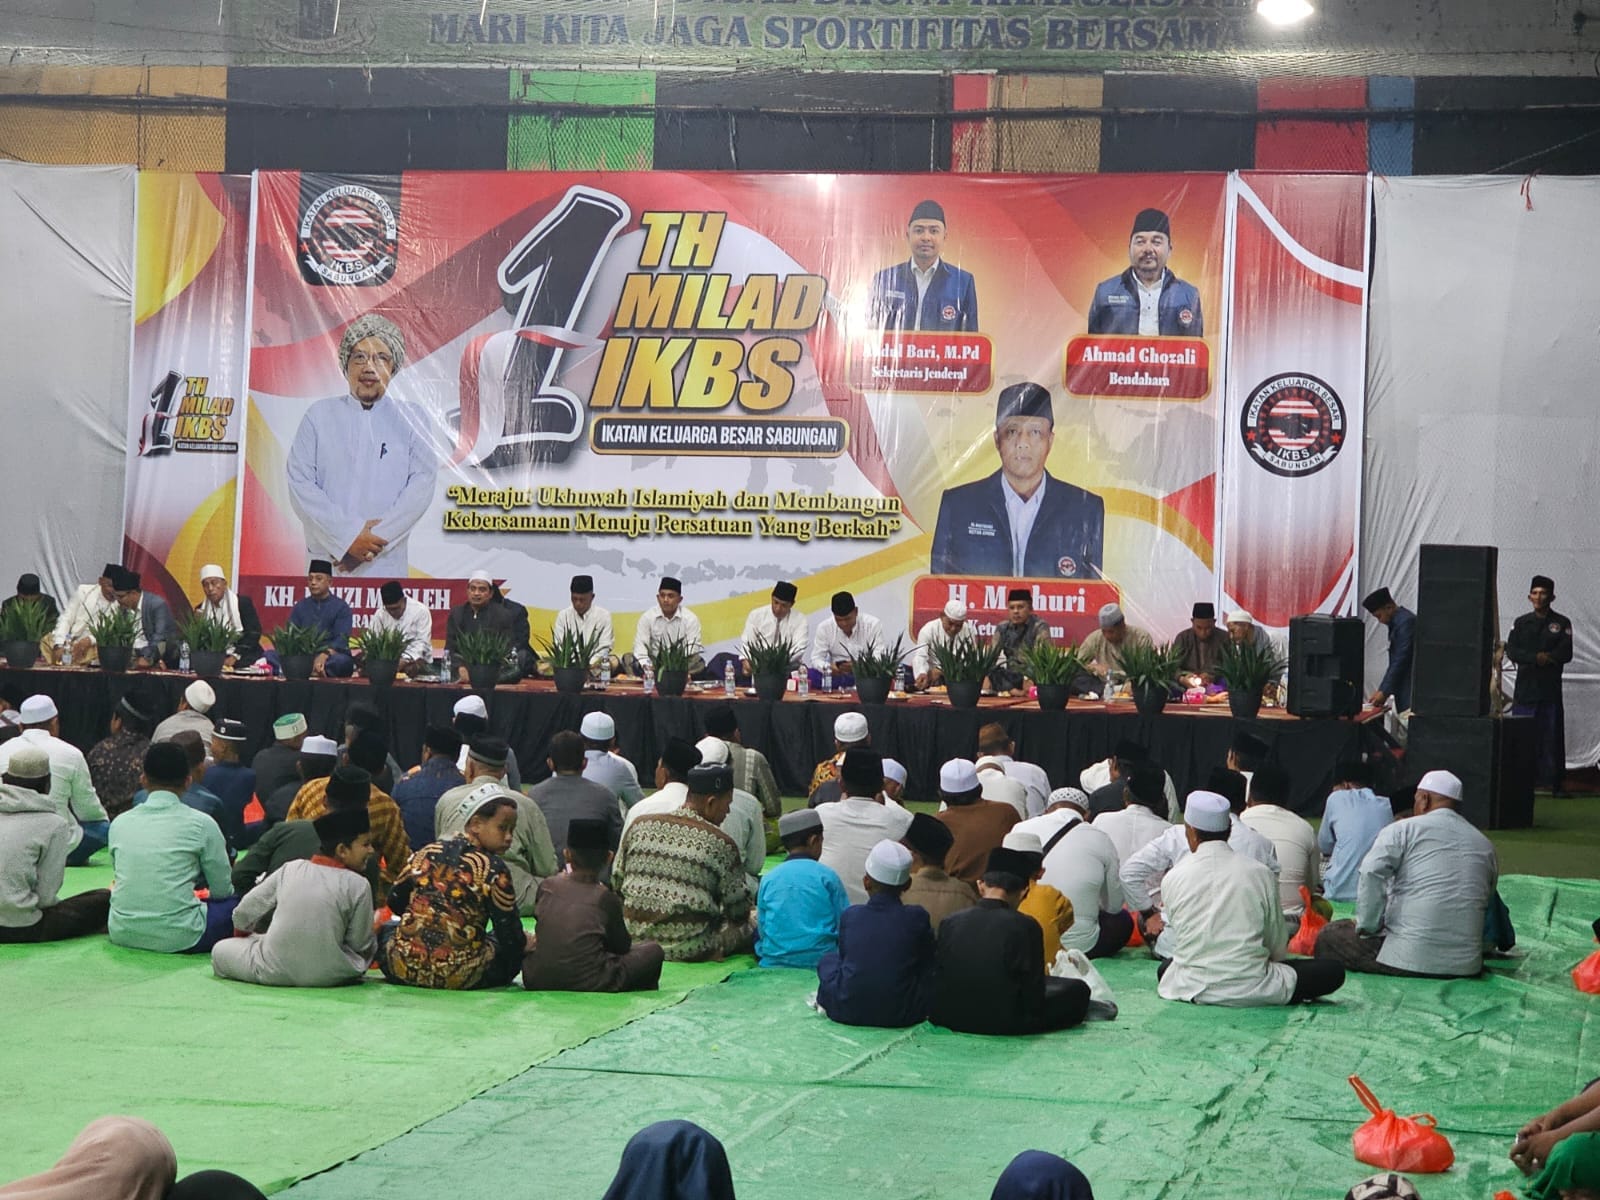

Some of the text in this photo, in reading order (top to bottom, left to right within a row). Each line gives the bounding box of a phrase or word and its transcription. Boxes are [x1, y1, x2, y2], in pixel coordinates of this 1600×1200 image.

[429, 13, 526, 45] MARI
[542, 14, 629, 46] KITA
[643, 14, 751, 48] JAGA
[764, 16, 1031, 51] SPORTIFITAS
[303, 199, 325, 230] IKATAN
[639, 211, 727, 268] TH
[330, 260, 363, 273] IKBS
[612, 273, 829, 331] MILAD
[906, 344, 941, 361] Bari,
[944, 345, 980, 360] M.Pd
[1082, 346, 1196, 365] Ahmad Ghozali
[588, 335, 802, 414] IKBS
[871, 364, 968, 382] Sekretaris Jenderal
[1109, 371, 1170, 387] Bendahara
[185, 377, 209, 396] TH
[179, 396, 235, 416] MILAD
[1248, 378, 1340, 421] IKATAN KELUARGA BESAR
[173, 415, 228, 440] IKBS
[602, 423, 837, 446] IKATAN KELUARGA BESAR SABUNGAN
[1269, 454, 1321, 469] SABUNGAN
[1277, 448, 1310, 460] IKBS
[538, 487, 629, 506] Ukhuwah
[632, 489, 728, 512] Islamiyah
[733, 491, 769, 509] dan
[444, 510, 572, 531] Kebersamaan
[575, 511, 651, 537] Menuju
[655, 513, 751, 533] Persatuan
[759, 516, 811, 541] Yang
[264, 585, 297, 607] KH.
[947, 584, 1086, 612] H. Mhuri
